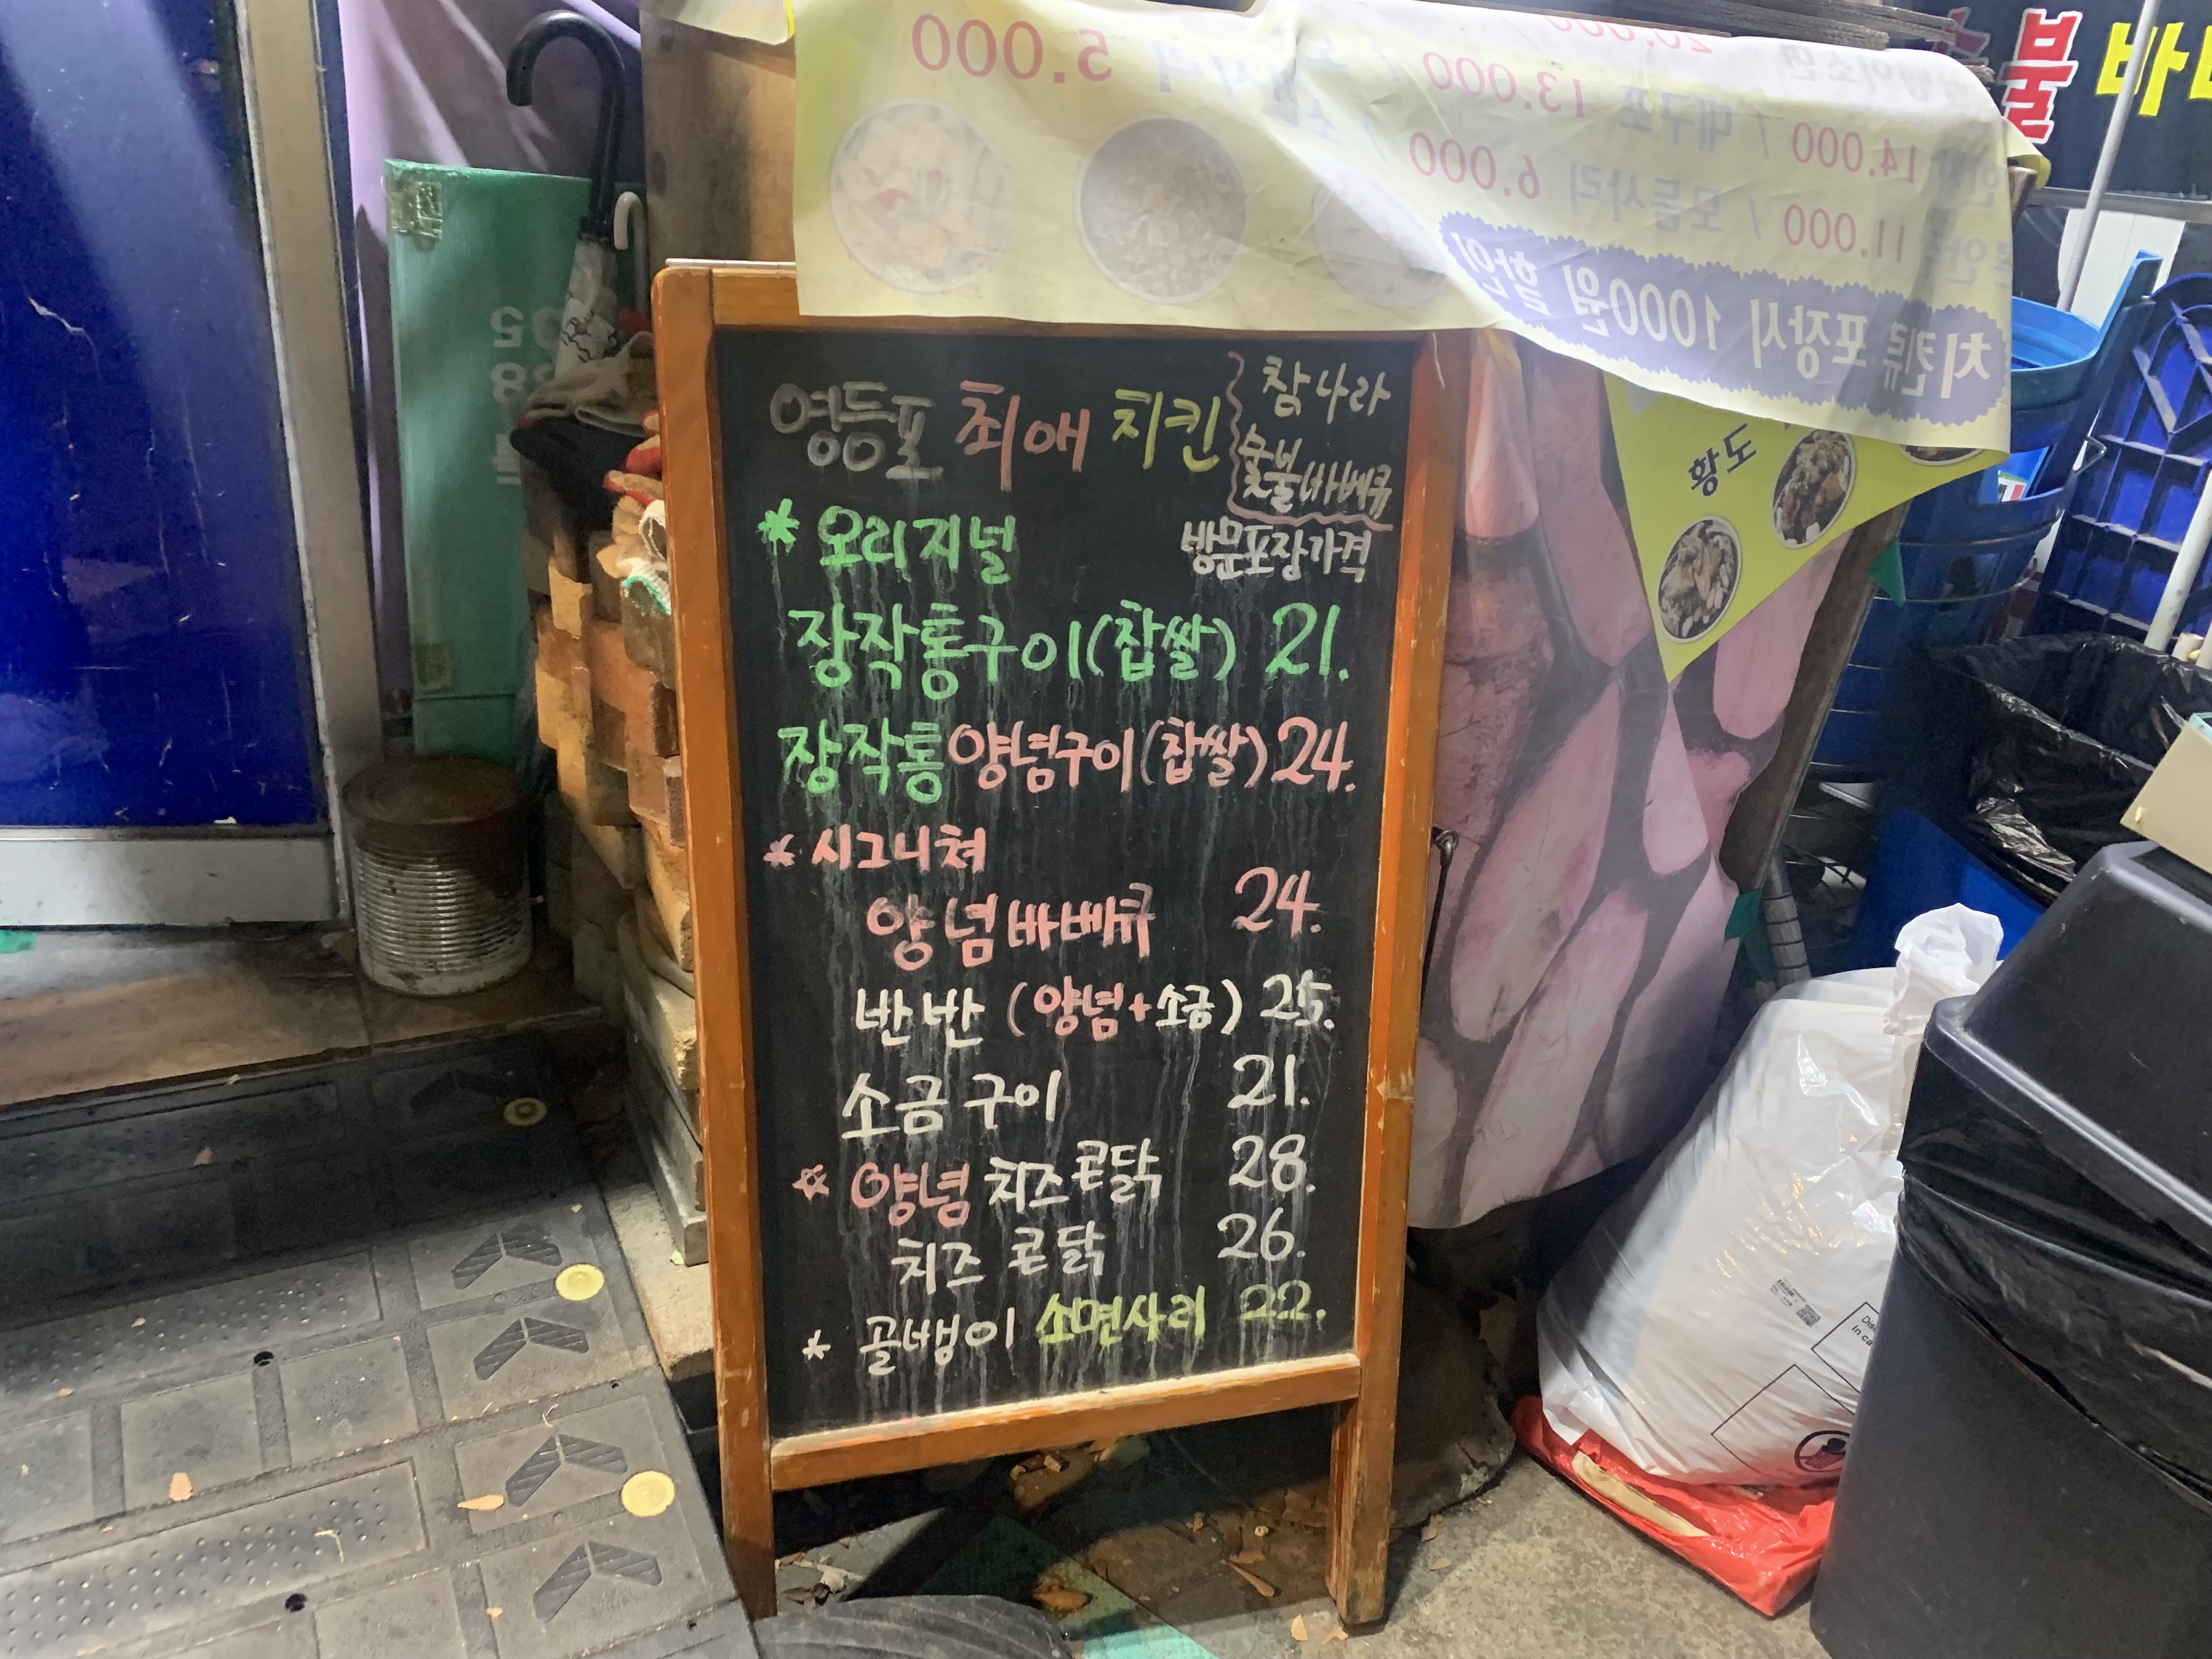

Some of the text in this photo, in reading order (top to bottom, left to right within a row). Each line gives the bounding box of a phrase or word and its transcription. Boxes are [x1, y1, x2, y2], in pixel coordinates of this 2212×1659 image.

[1263, 356, 1391, 424] 참나라
[770, 380, 1221, 490] 영등포 최애 치킨
[1688, 422, 1756, 496] 황도
[819, 506, 1016, 584] 오리지널
[855, 988, 985, 1050] 반반
[851, 1161, 969, 1227] 양념
[891, 1238, 985, 1295] 치즈
[860, 1307, 1015, 1375] 골뱅이
